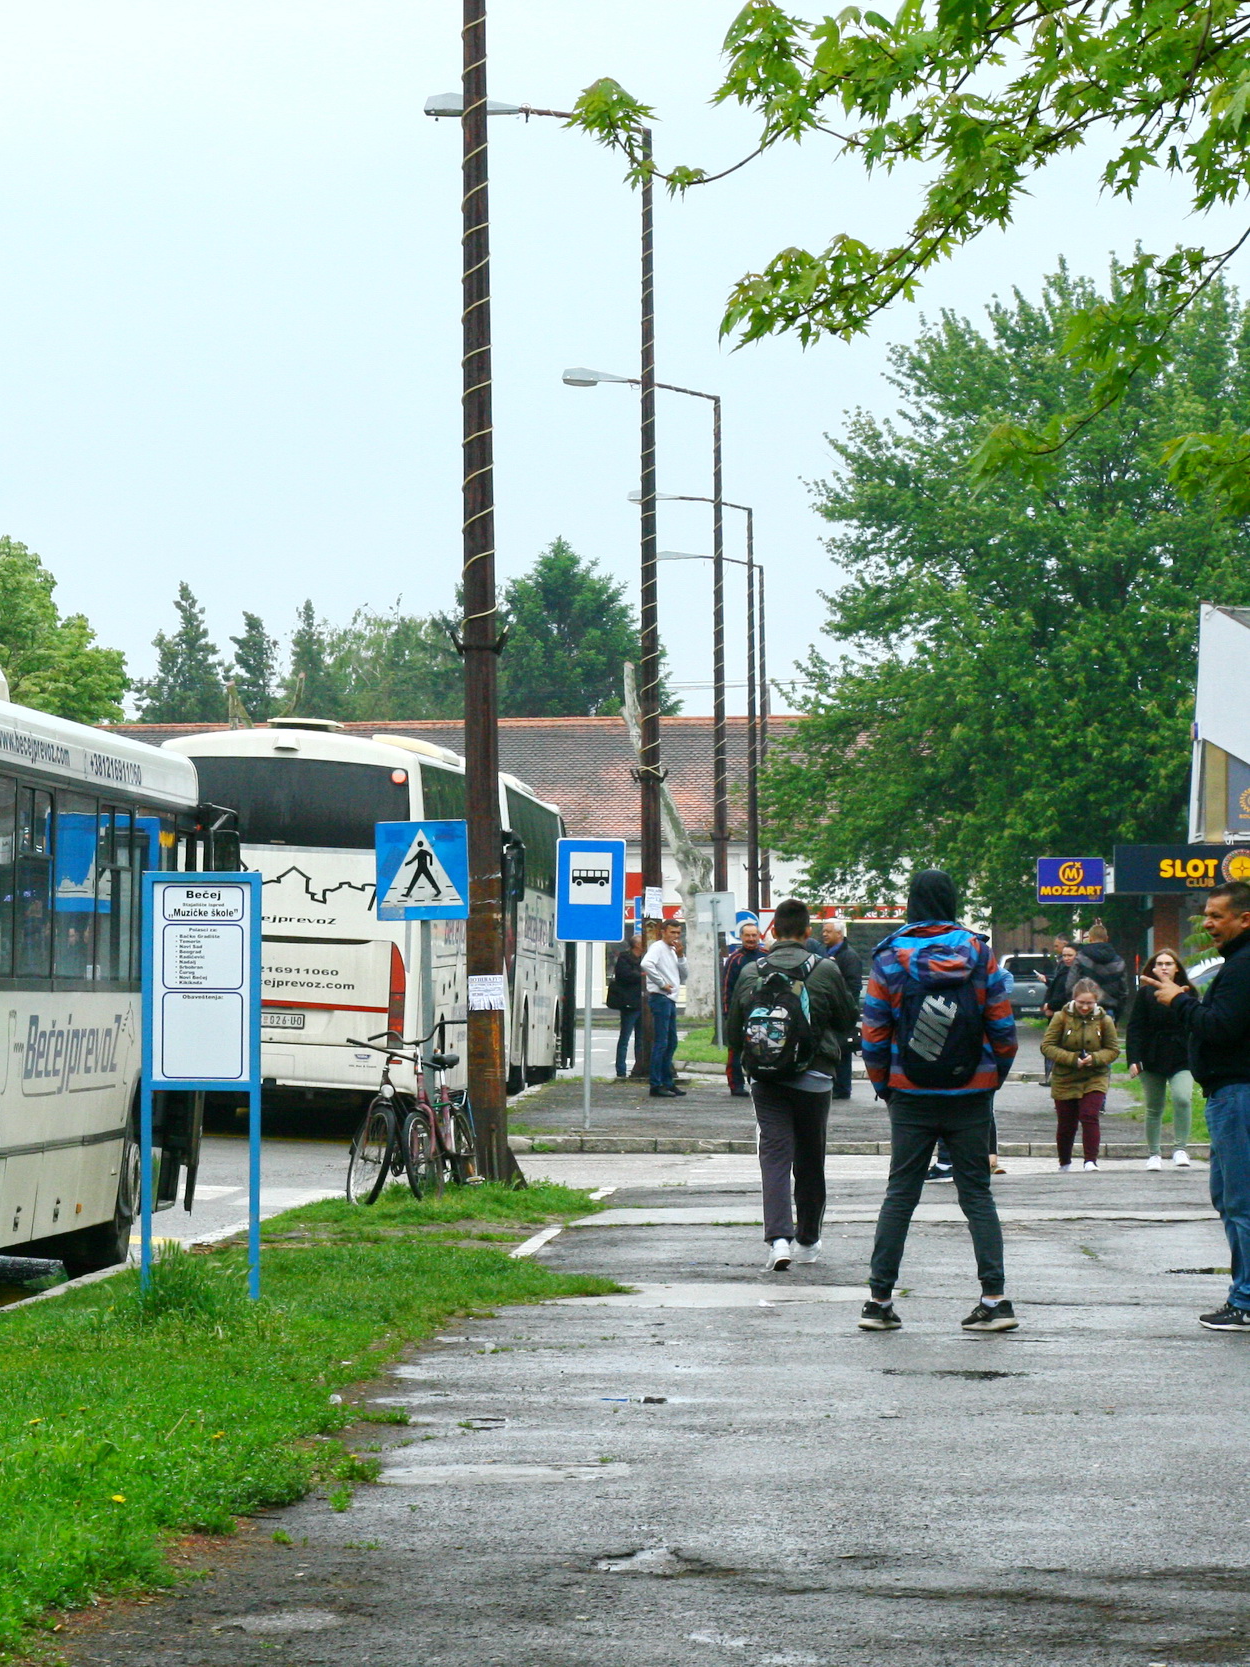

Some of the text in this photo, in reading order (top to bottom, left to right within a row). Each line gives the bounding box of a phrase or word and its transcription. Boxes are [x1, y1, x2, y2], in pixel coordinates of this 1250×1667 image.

[1159, 858, 1219, 879] SLOT
[1186, 878, 1216, 888] CLUB
[186, 890, 221, 901] Bečej
[1040, 885, 1103, 896] MOZZART
[261, 915, 337, 926] ejprevoZ
[261, 978, 355, 991] ejprevoz.com
[908, 994, 958, 1062] NIKE
[23, 1013, 123, 1095] BečejprevoZ
